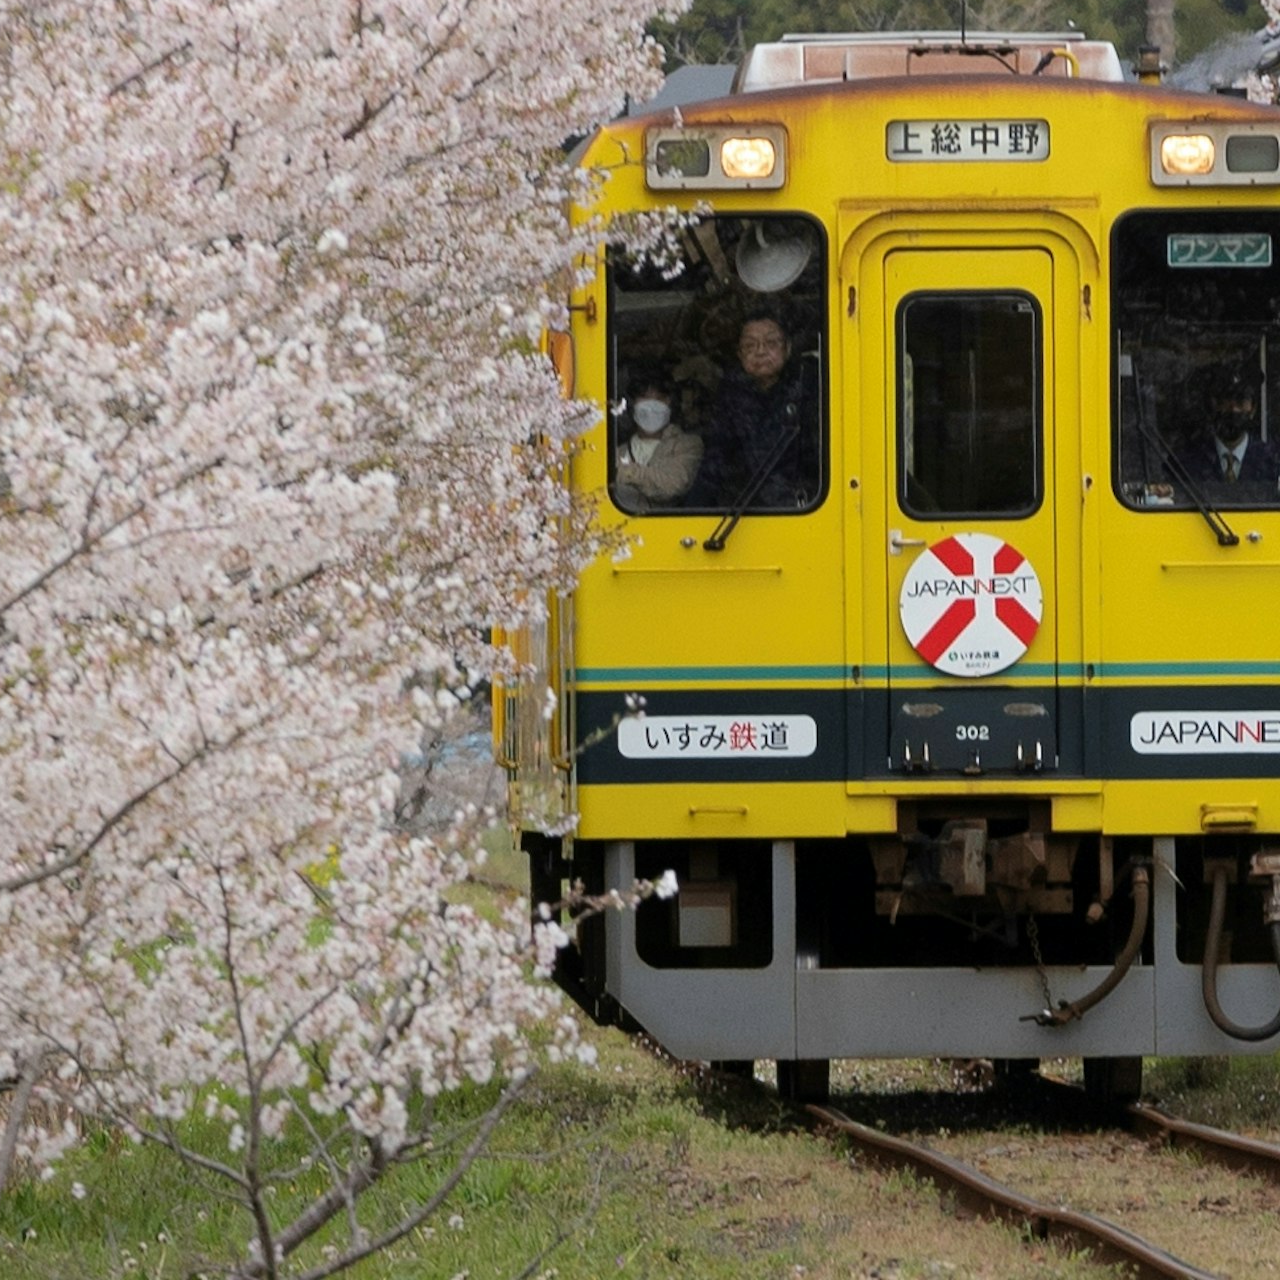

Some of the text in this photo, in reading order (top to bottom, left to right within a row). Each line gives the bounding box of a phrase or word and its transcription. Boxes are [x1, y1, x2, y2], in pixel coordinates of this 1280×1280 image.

[892, 123, 1039, 155] 上総中野
[1172, 239, 1267, 262] ワンマン
[907, 576, 1035, 598] JAPANNEXT
[645, 721, 789, 751] いすみ鉄道
[955, 725, 990, 741] 302
